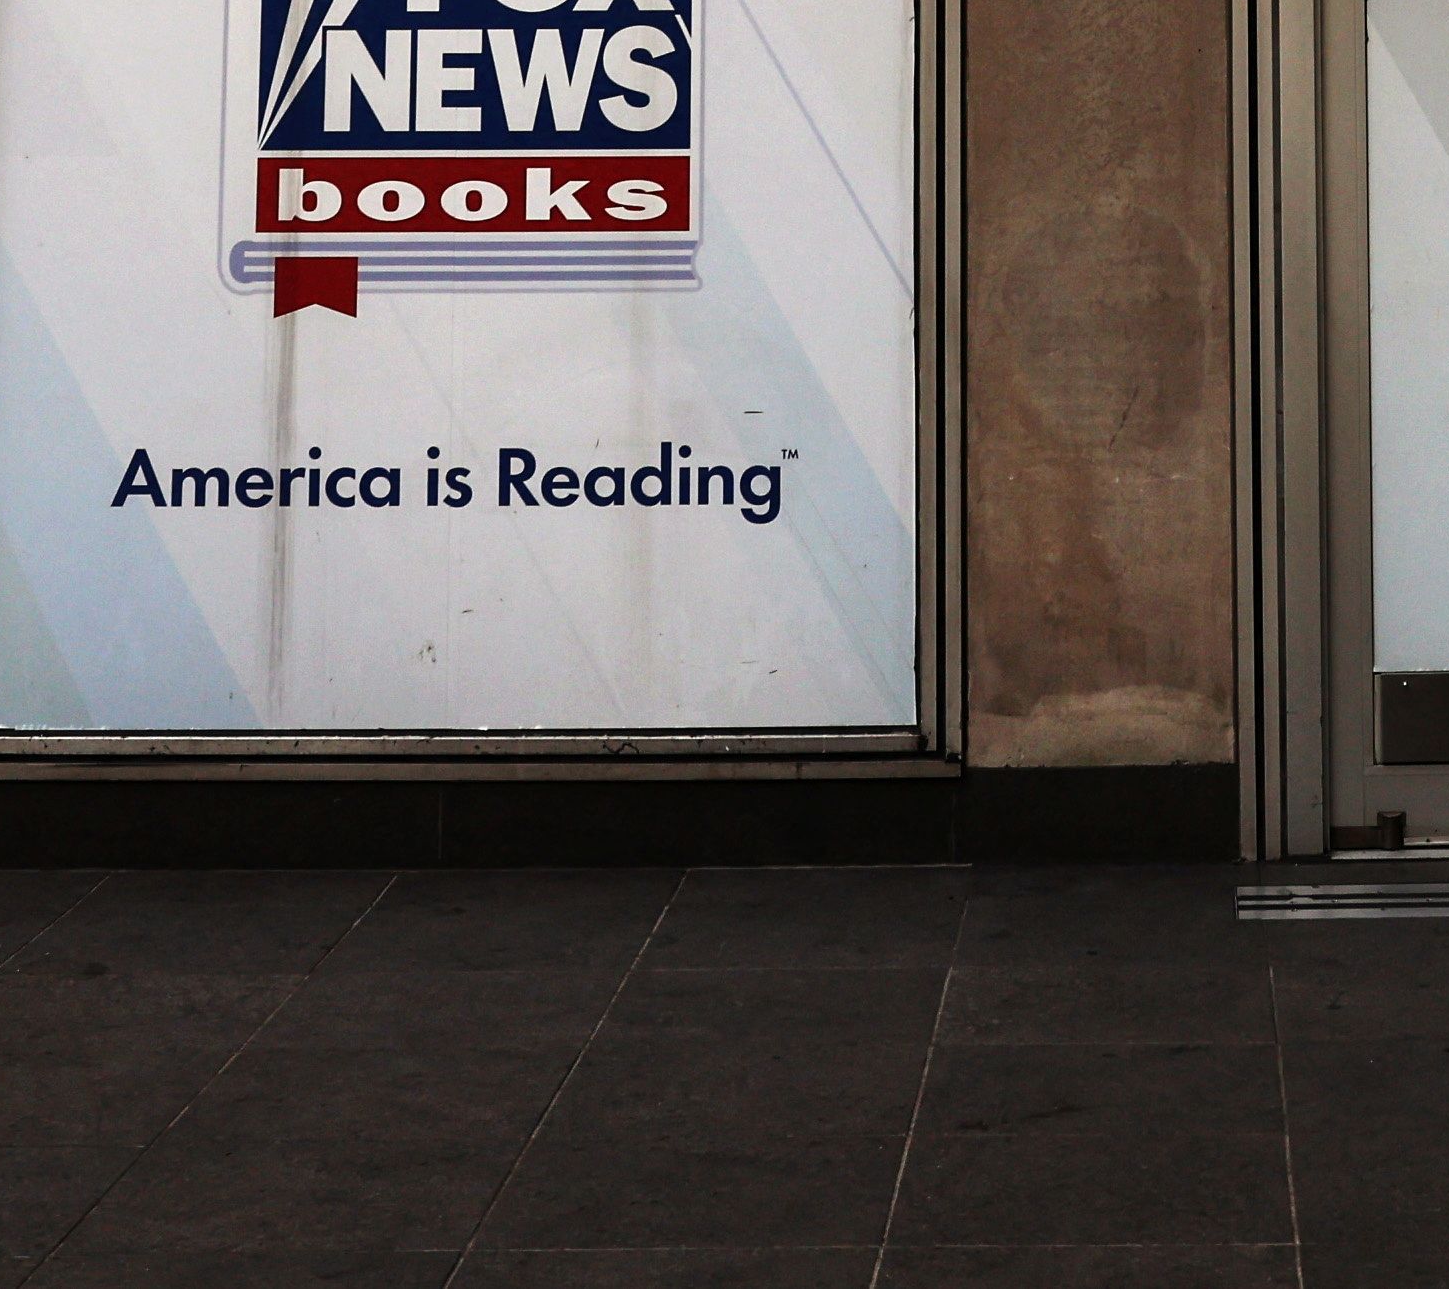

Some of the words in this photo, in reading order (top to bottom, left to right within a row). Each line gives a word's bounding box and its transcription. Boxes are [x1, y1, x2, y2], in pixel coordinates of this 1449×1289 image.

[324, 26, 676, 132] NEWS
[278, 168, 668, 221] books
[110, 447, 402, 509] America
[426, 447, 474, 508] is
